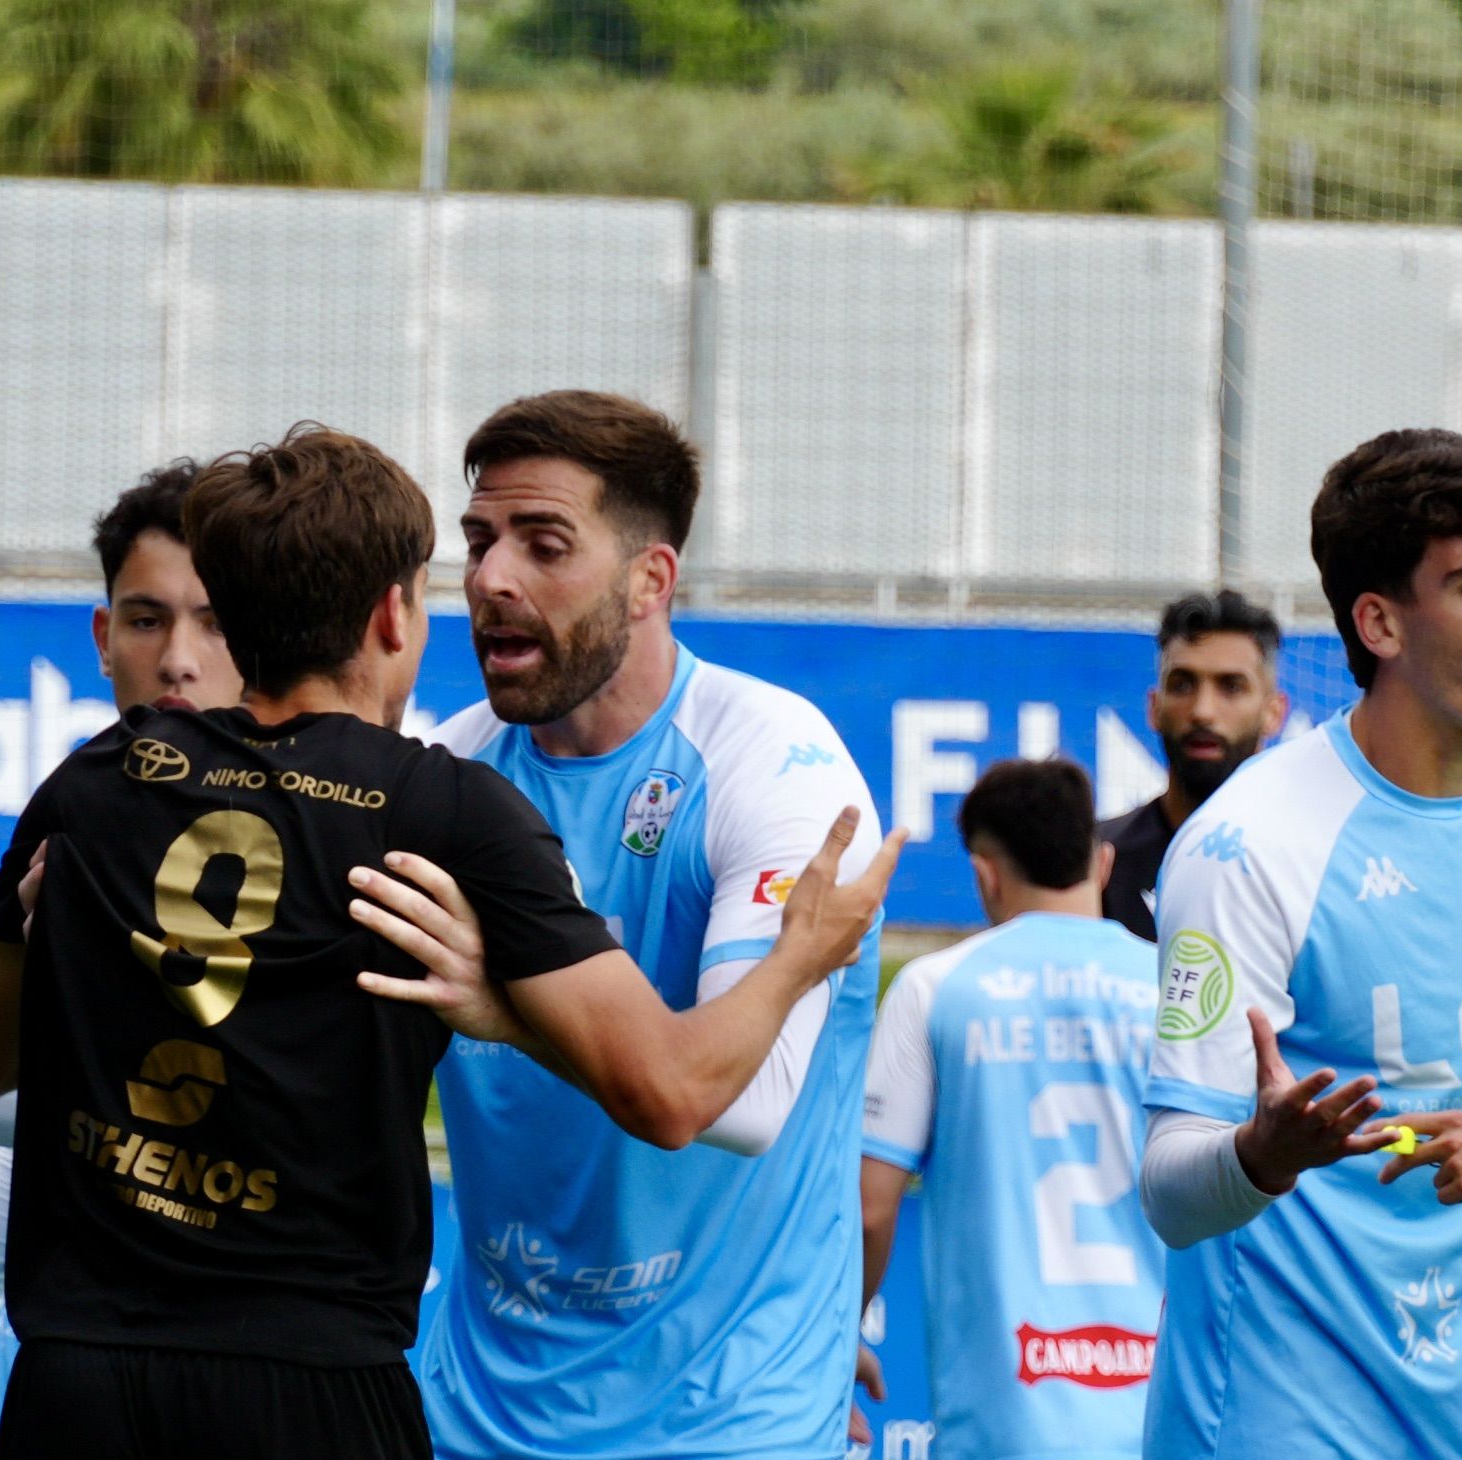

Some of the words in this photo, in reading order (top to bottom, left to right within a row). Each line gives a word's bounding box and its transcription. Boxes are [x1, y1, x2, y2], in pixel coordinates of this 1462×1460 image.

[201, 768, 267, 790] NIMO
[274, 770, 387, 810] ORDILLO
[67, 1109, 279, 1213] STHENOS
